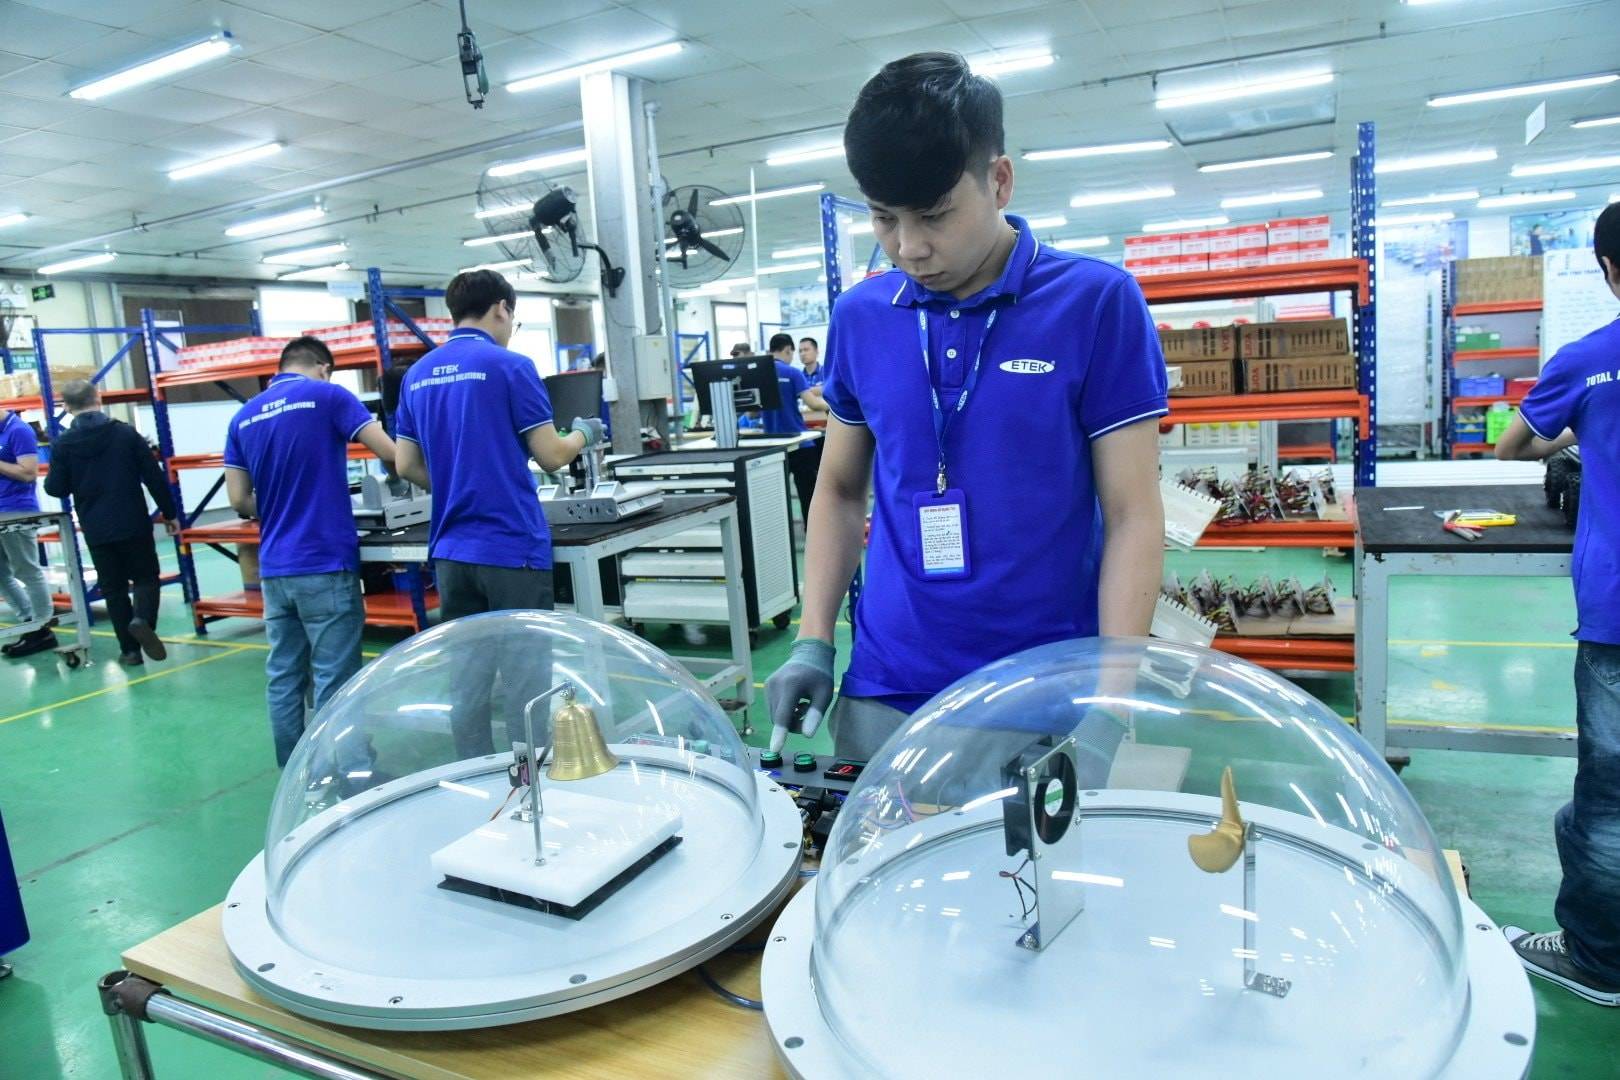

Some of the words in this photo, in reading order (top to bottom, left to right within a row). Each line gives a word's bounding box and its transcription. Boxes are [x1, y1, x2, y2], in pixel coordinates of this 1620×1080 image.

[432, 364, 459, 376] ETEK
[1011, 360, 1047, 372] ETEK
[1586, 371, 1613, 387] TOTAL
[262, 397, 287, 412] ETEK
